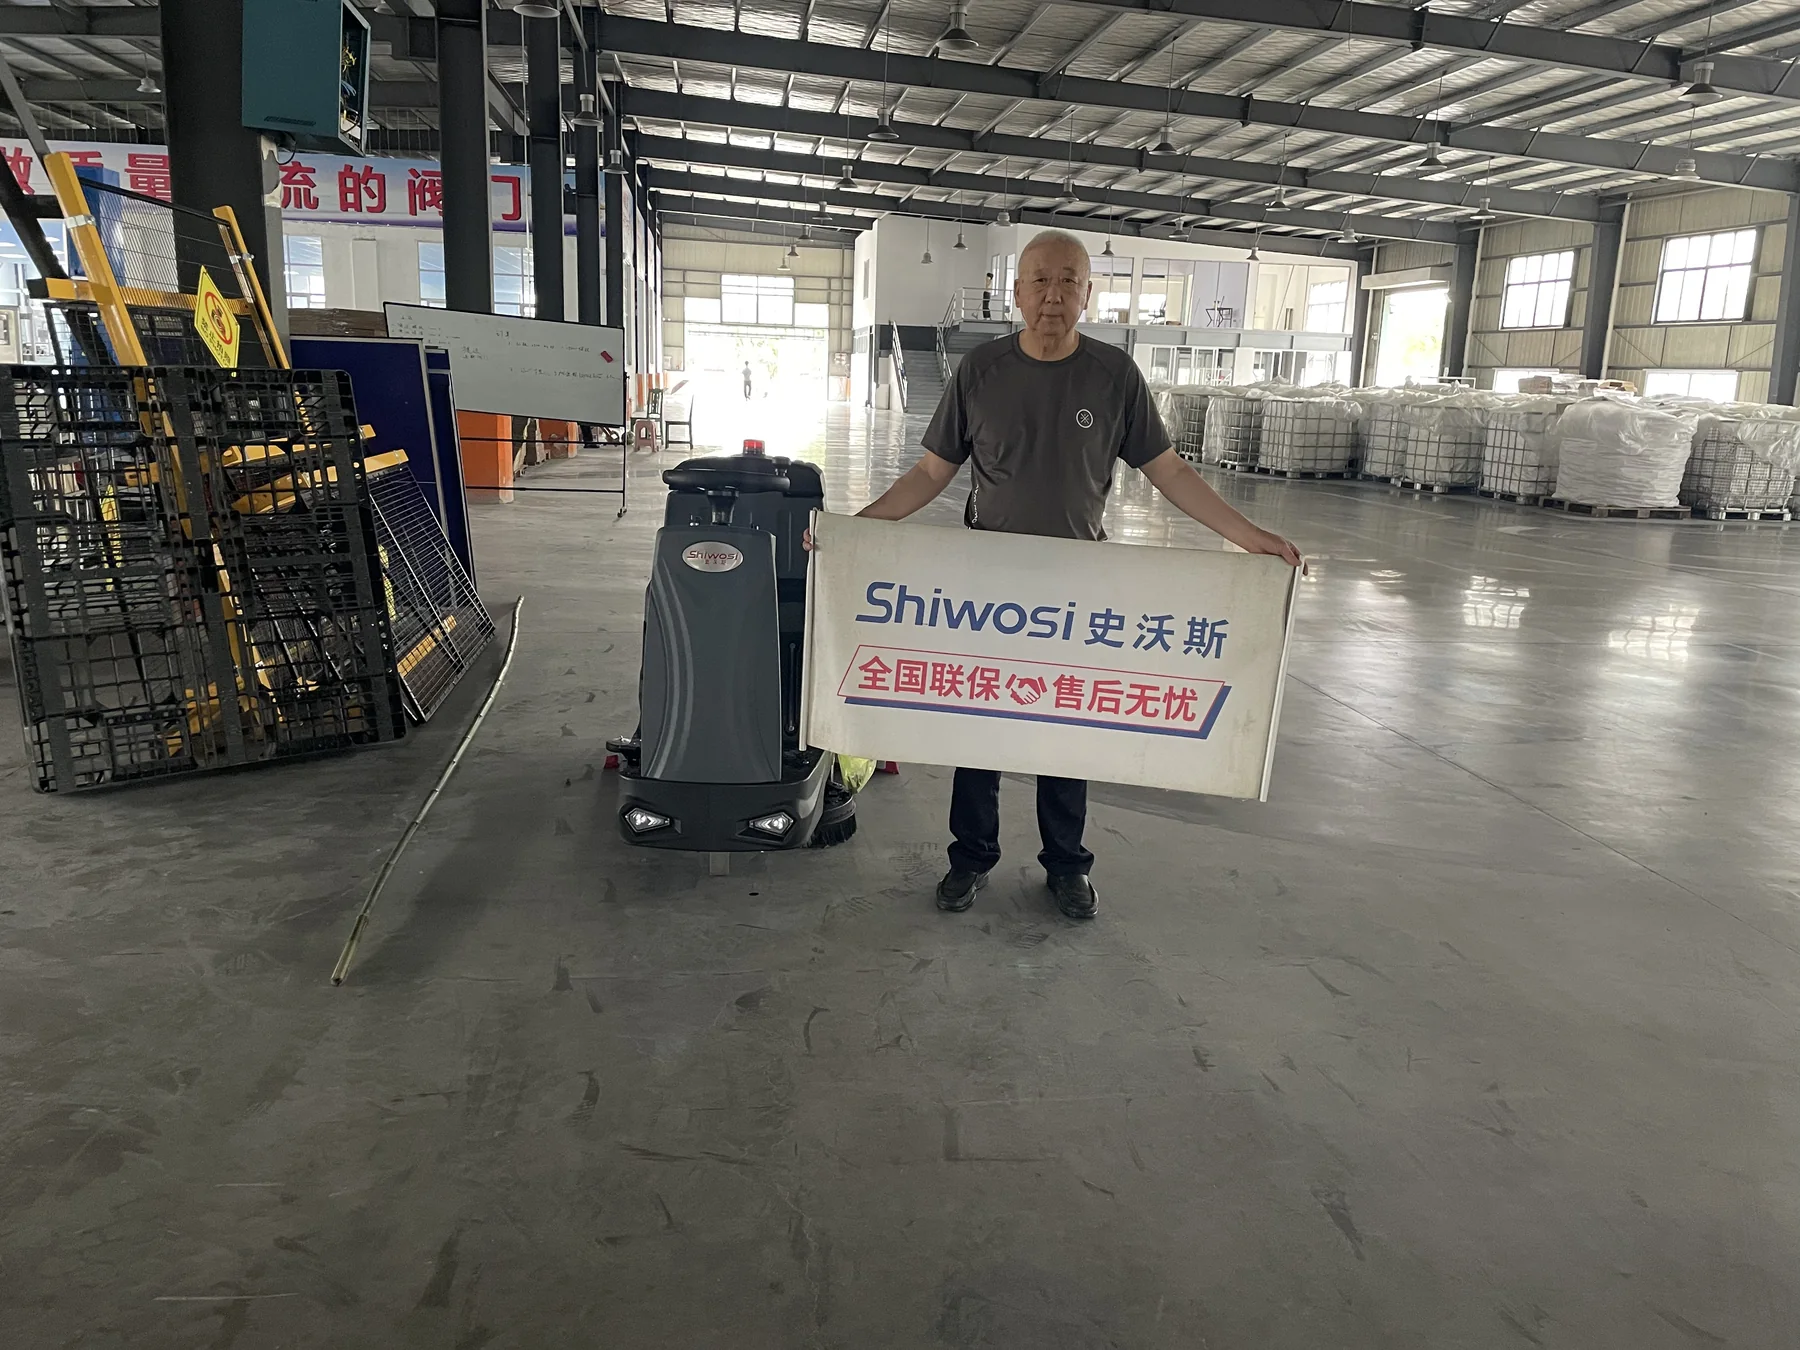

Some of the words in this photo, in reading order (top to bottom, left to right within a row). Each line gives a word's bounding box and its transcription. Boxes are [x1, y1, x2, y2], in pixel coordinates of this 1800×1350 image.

[686, 550, 739, 561] Shiwosi
[855, 581, 1076, 641] Shiwosi
[1084, 608, 1230, 660] 史沃斯
[858, 656, 1001, 701] 全国联保
[1053, 674, 1199, 722] 售后无忧
